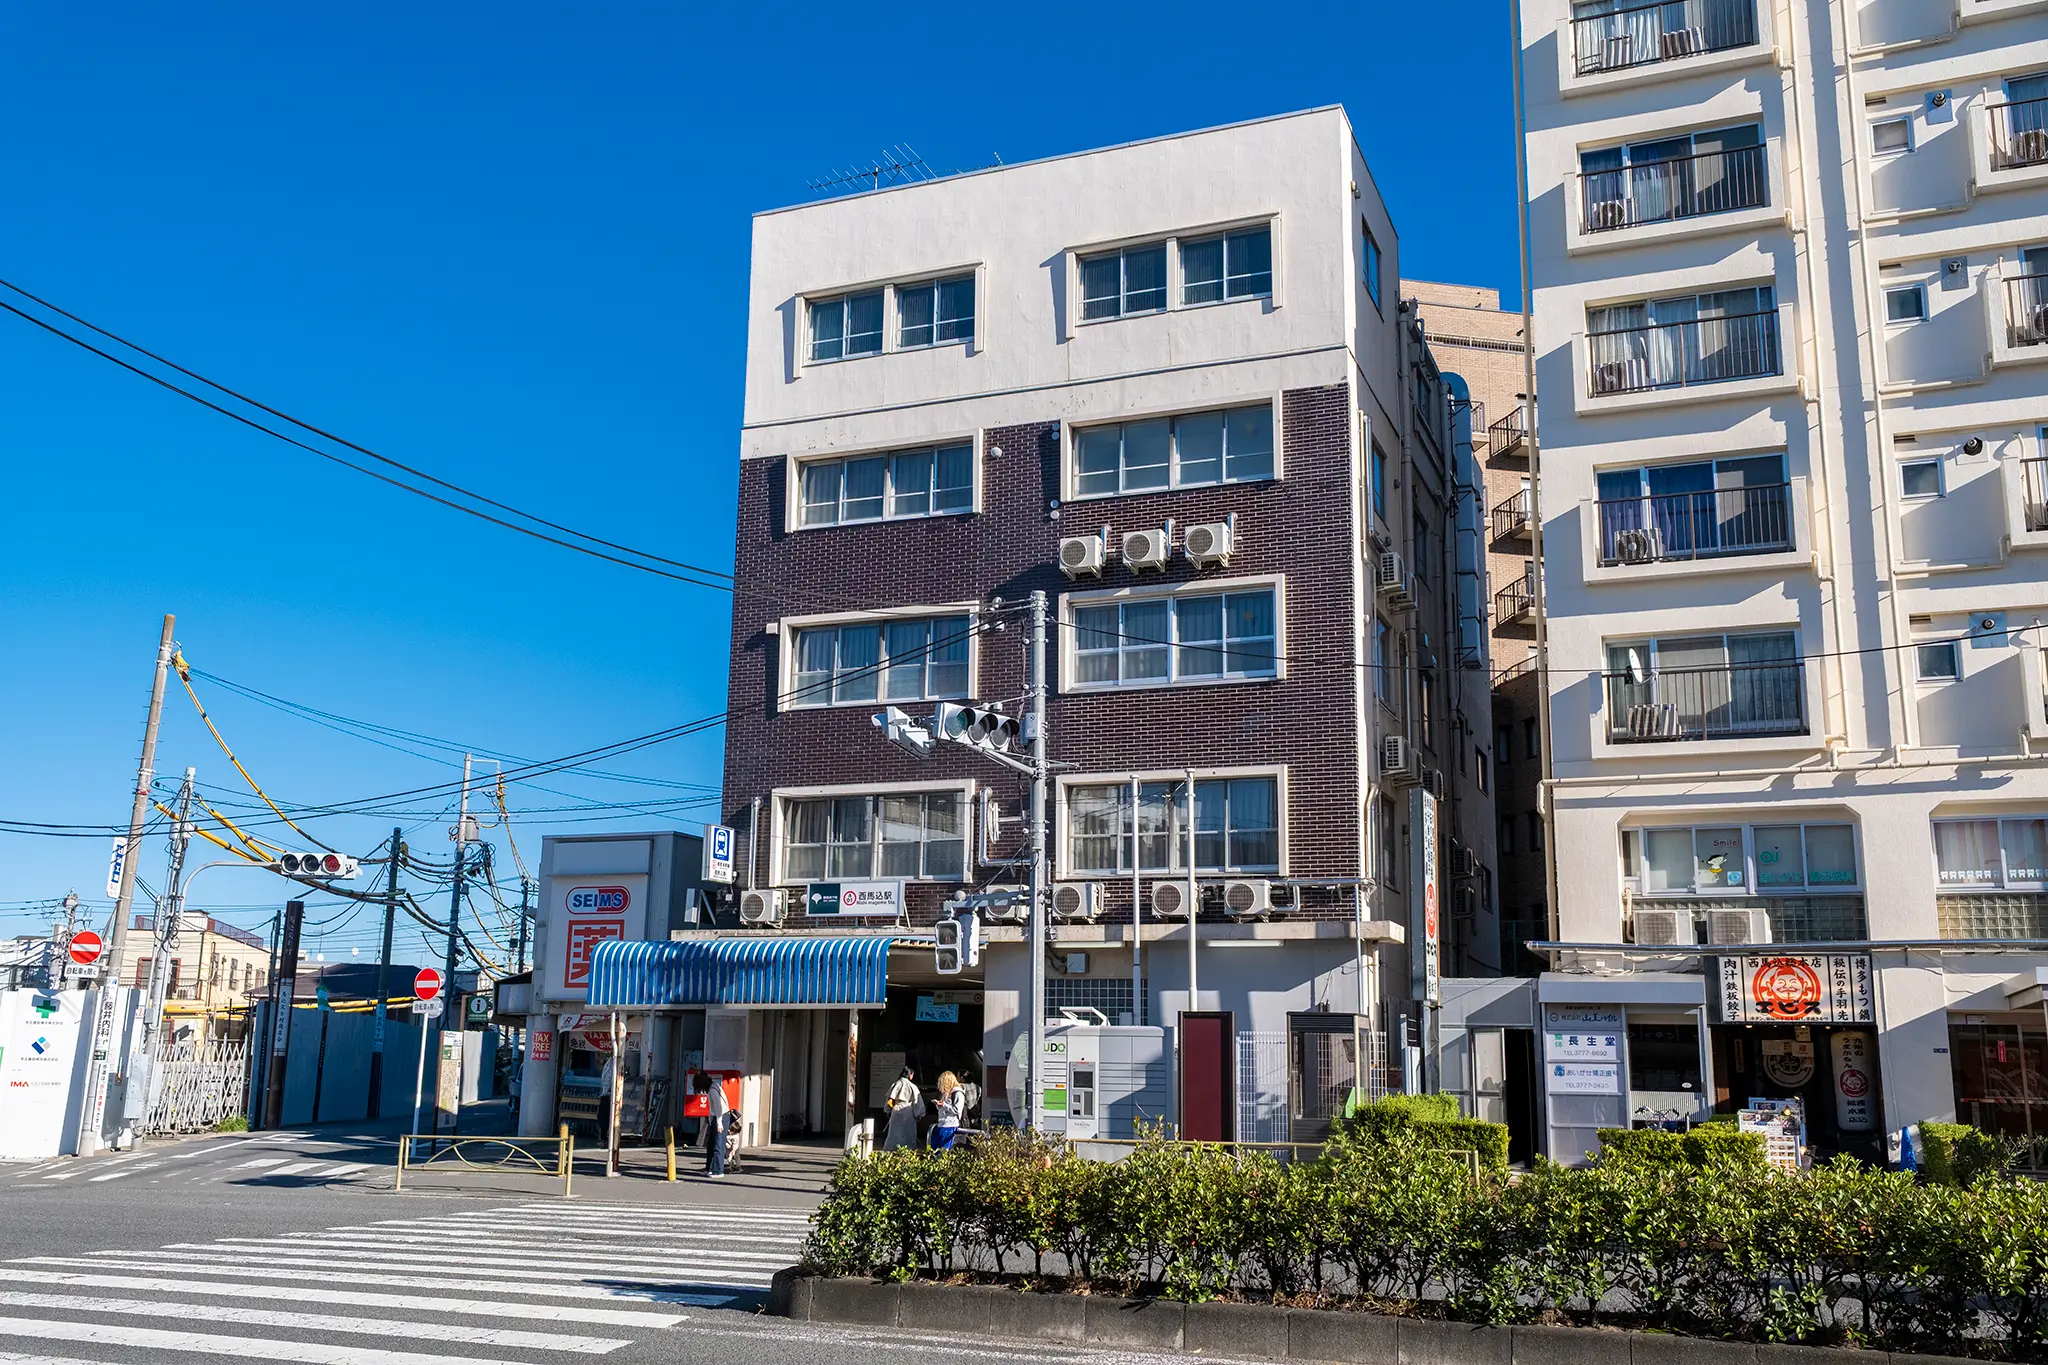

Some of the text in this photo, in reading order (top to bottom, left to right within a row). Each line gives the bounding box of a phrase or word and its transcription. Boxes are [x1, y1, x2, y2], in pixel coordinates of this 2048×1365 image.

[572, 893, 623, 908] SEIMS
[858, 891, 892, 901] 西馬込駅
[1748, 957, 1822, 968] 西馬込総本店
[66, 966, 97, 975] 自転車を除く
[1724, 958, 1740, 1021] 肉汁鉄板餃子
[1833, 957, 1849, 1021] 秘伝の手羽先
[1855, 957, 1871, 1021] 博多もつ鍋
[1754, 1000, 1821, 1015] エビス
[534, 1032, 550, 1041] TAX
[1568, 1035, 1616, 1047] 長生堂
[532, 1042, 550, 1052] FREE
[1044, 1043, 1066, 1052] UDO
